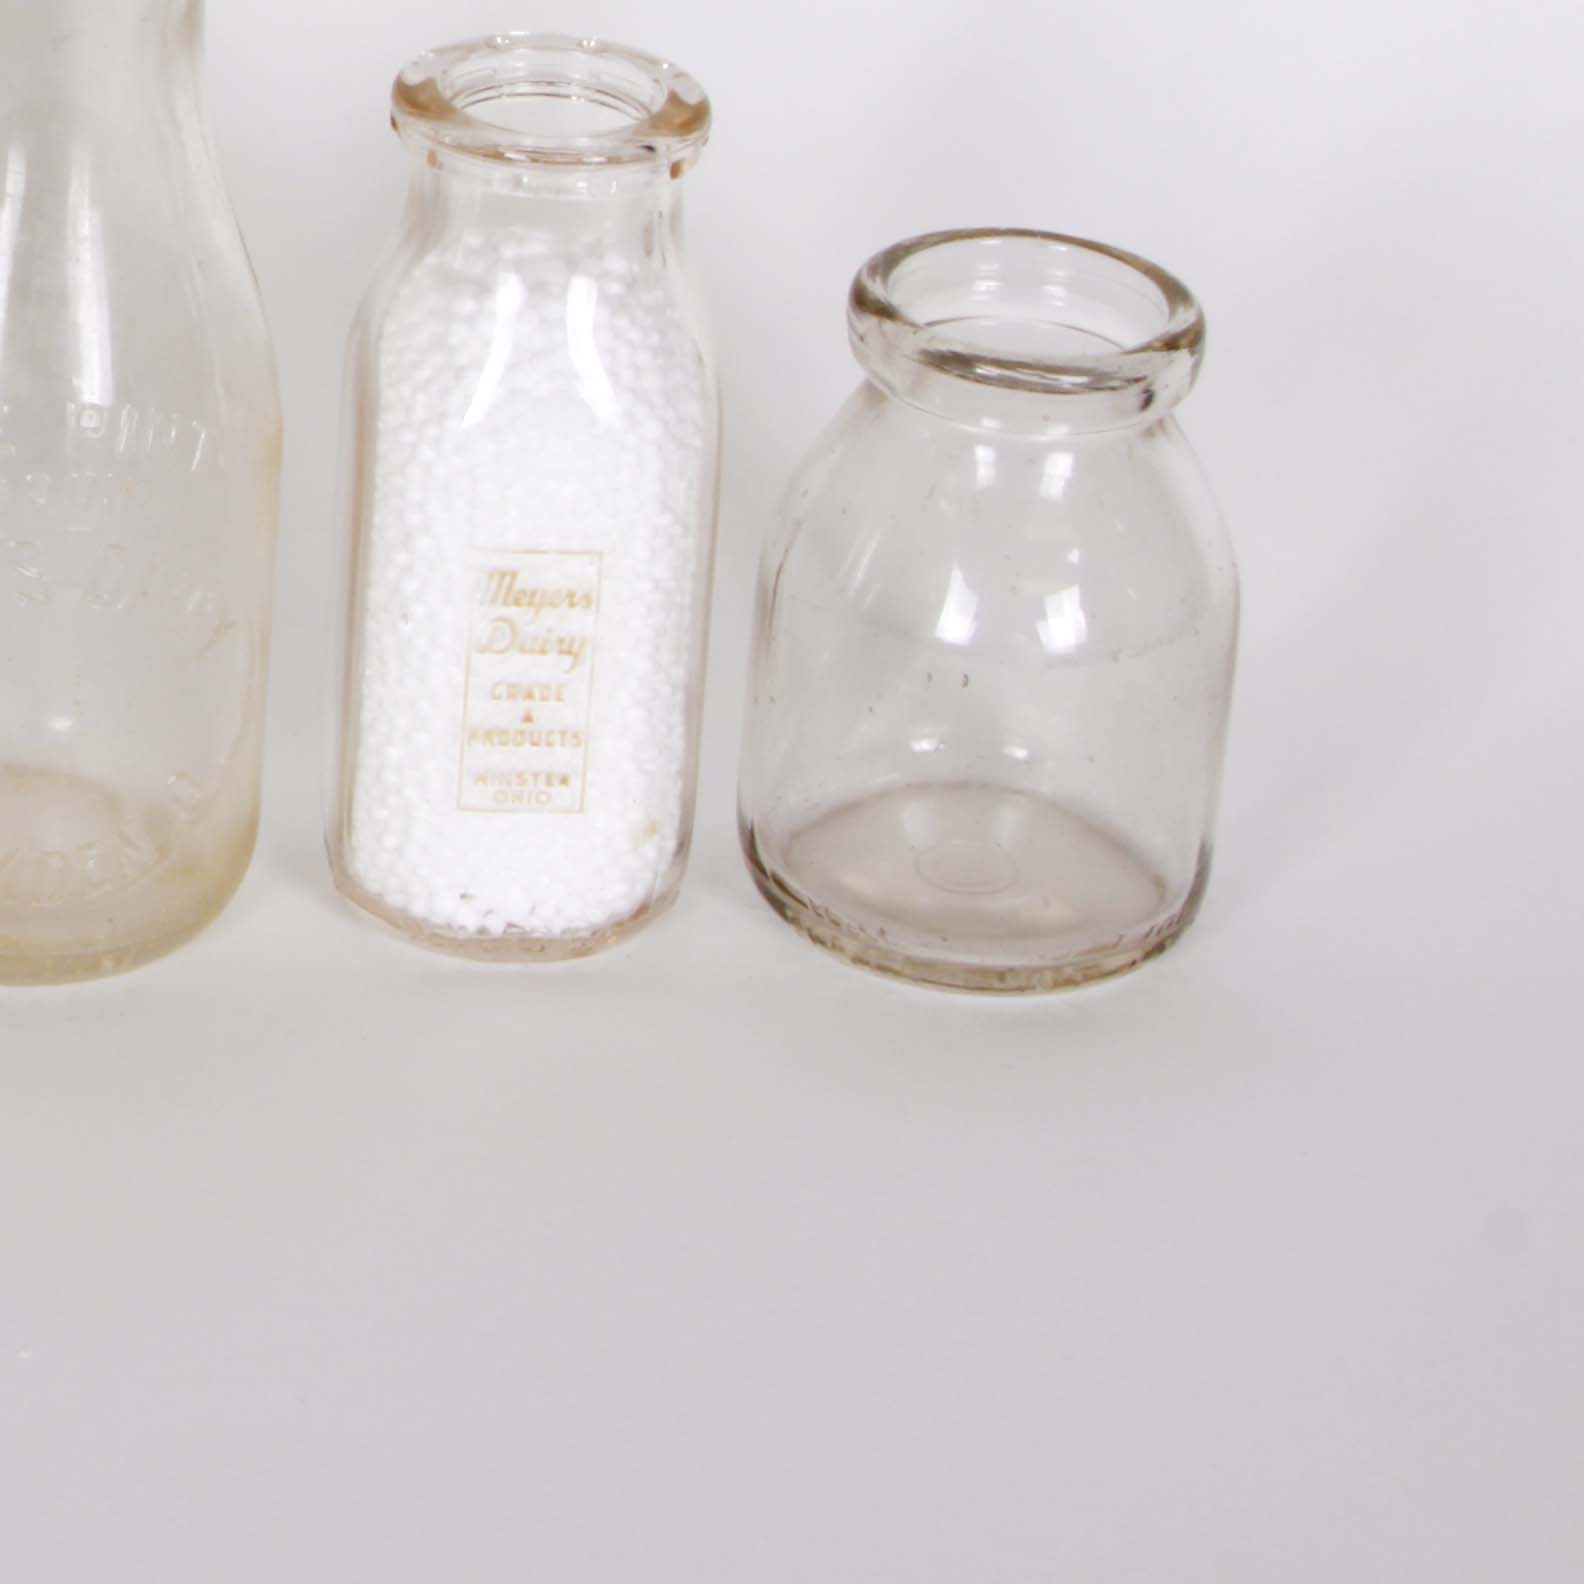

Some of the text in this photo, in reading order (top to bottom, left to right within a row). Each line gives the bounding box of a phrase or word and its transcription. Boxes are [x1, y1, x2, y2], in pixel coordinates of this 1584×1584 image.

[477, 616, 589, 674] Dairy
[490, 681, 566, 704] GRADE
[467, 728, 584, 749] PRODUCTS
[492, 788, 552, 806] OHIO
